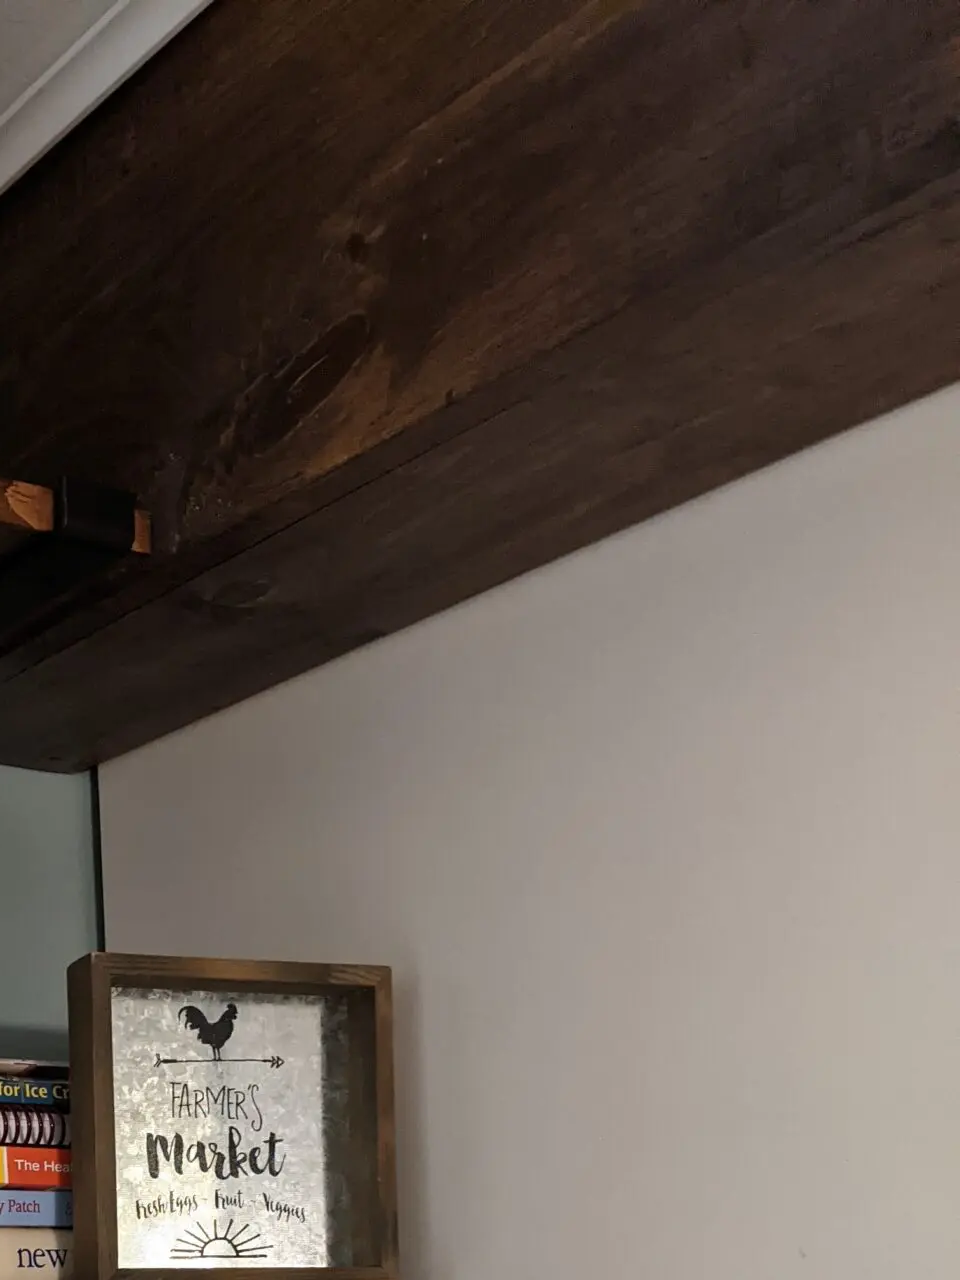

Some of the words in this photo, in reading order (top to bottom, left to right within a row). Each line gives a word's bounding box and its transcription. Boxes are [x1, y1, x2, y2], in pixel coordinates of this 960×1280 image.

[25, 1083, 48, 1098] Ice
[169, 1081, 264, 1132] FARMER'S
[146, 1126, 287, 1180] Market
[14, 1159, 40, 1172] The
[44, 1160, 72, 1173] Hea
[8, 1199, 41, 1214] Patch
[135, 1195, 167, 1220] Fresh
[169, 1190, 200, 1217] Eggs
[214, 1189, 245, 1210] Fruit
[262, 1192, 306, 1224] Veggies
[17, 1247, 68, 1268] new
